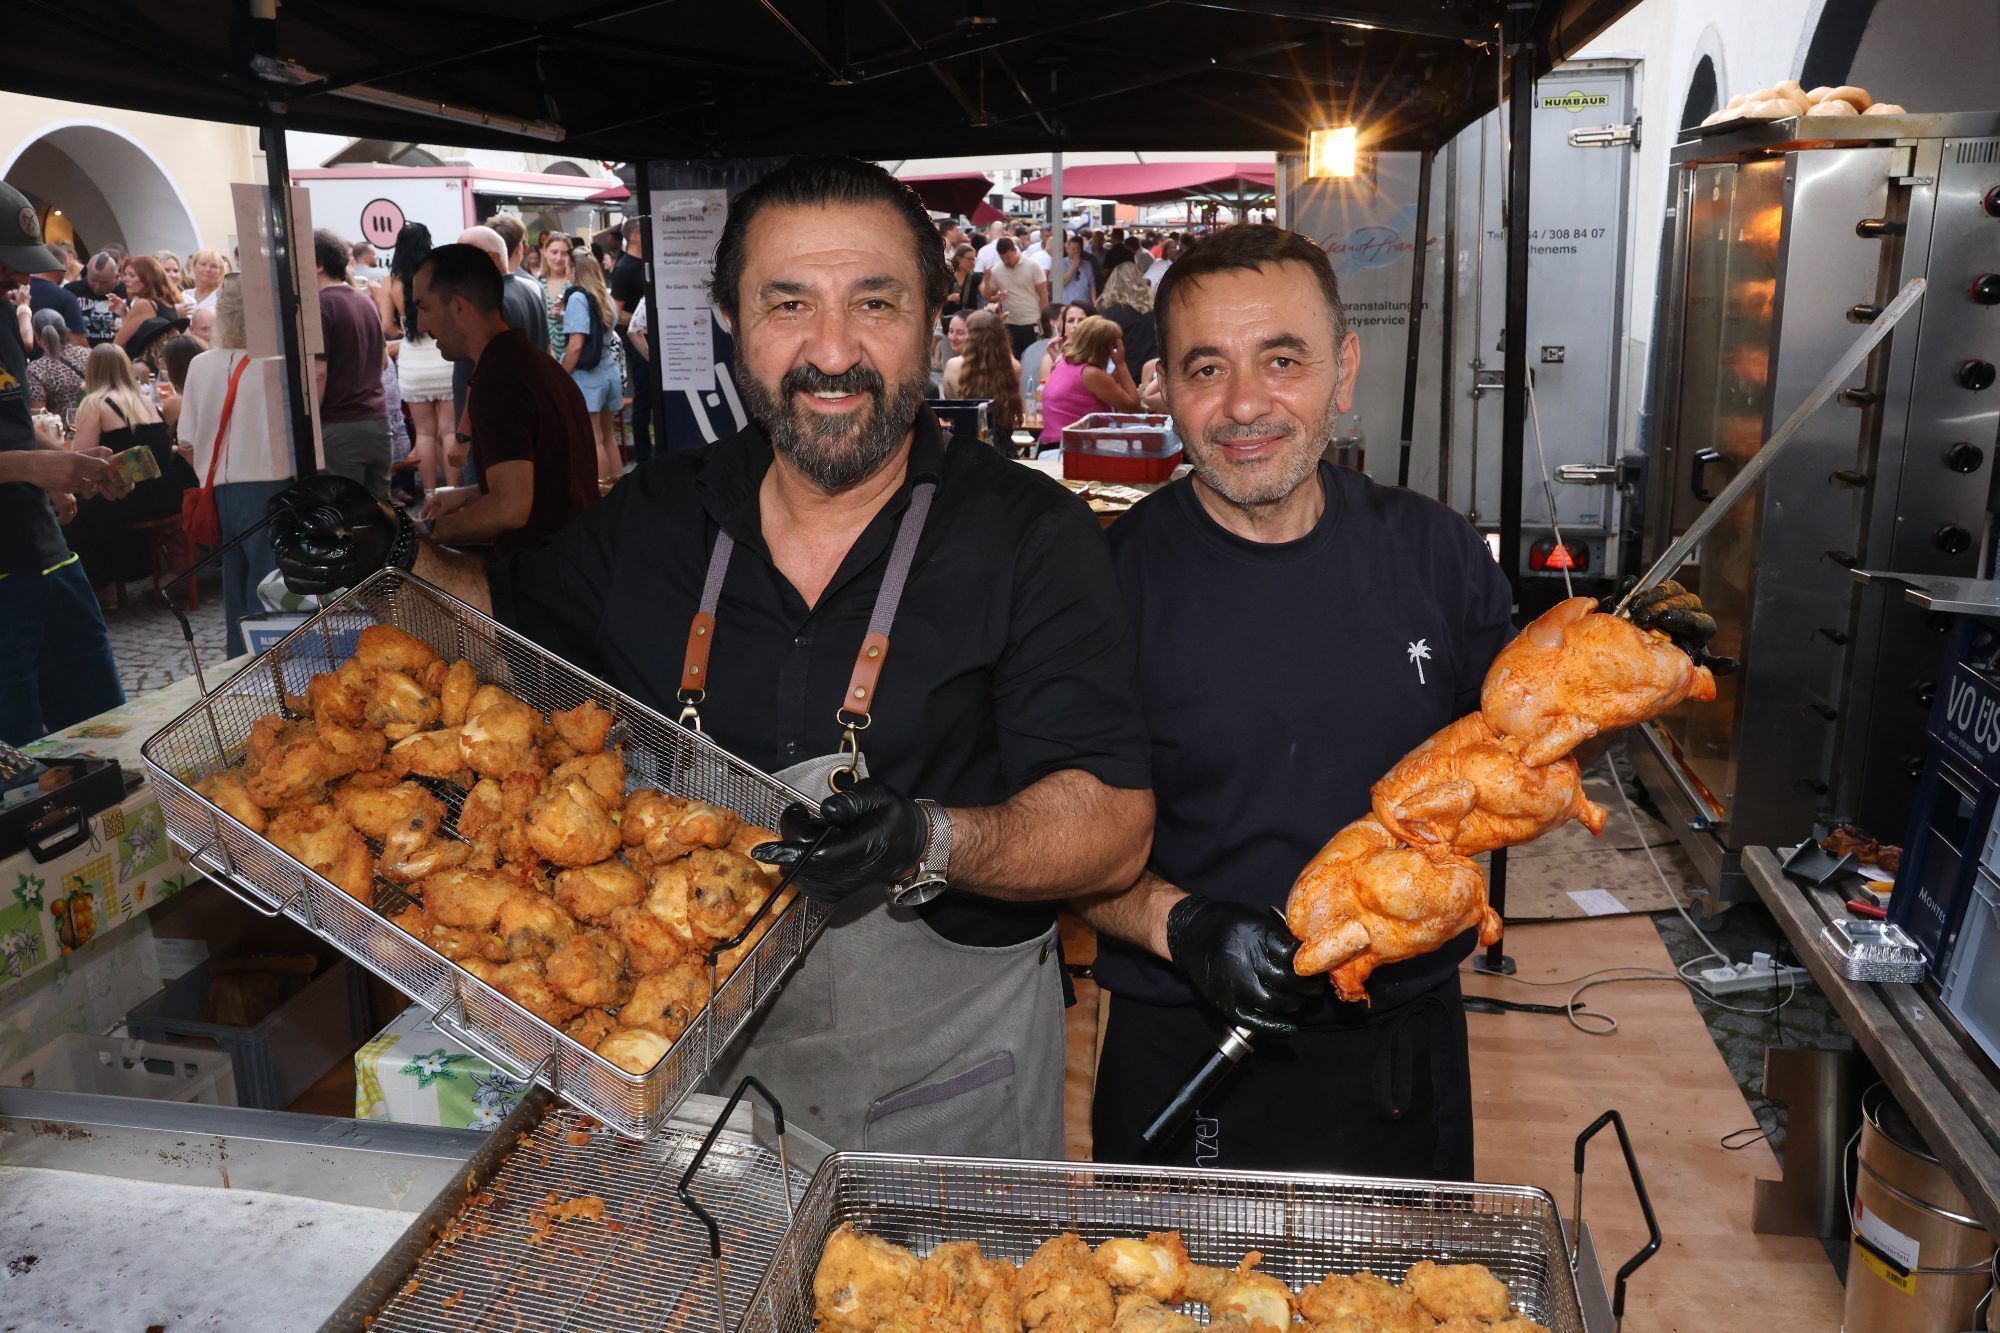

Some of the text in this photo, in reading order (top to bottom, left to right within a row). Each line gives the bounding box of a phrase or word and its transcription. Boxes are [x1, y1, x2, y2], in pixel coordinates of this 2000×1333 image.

[1544, 97, 1606, 107] HUMBAUR
[1549, 229, 1570, 240] 308
[1573, 228, 1587, 239] 84
[1591, 228, 1605, 239] 07
[1529, 245, 1577, 255] henems
[1343, 300, 1429, 313] eranstaltungn
[1347, 315, 1405, 328] rtyservice
[1946, 675, 1976, 731] VO
